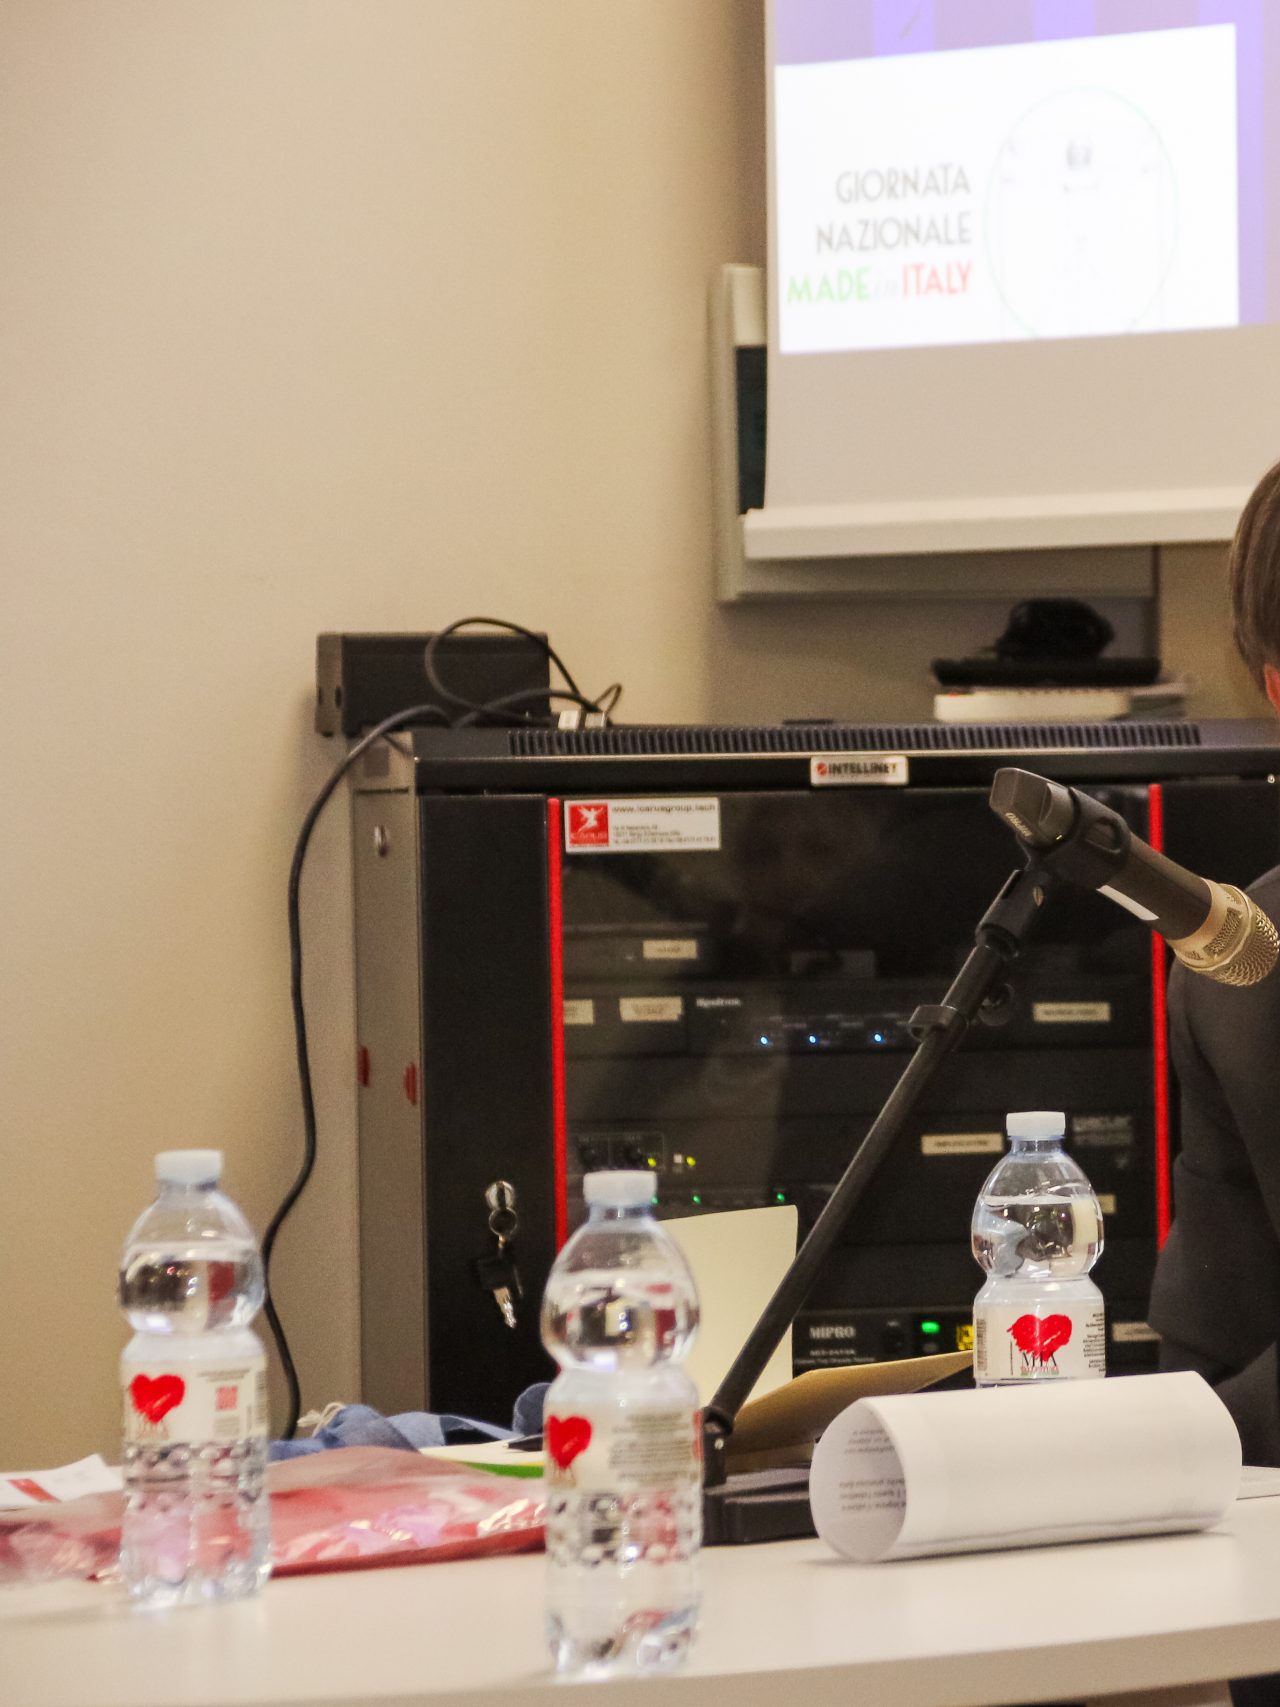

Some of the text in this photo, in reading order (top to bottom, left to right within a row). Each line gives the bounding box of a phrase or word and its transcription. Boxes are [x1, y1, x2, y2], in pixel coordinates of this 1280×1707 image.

[836, 165, 971, 204] GIORNATA
[816, 213, 971, 254] NAZIONALE
[787, 267, 871, 303] MADE
[903, 261, 973, 297] ITALY
